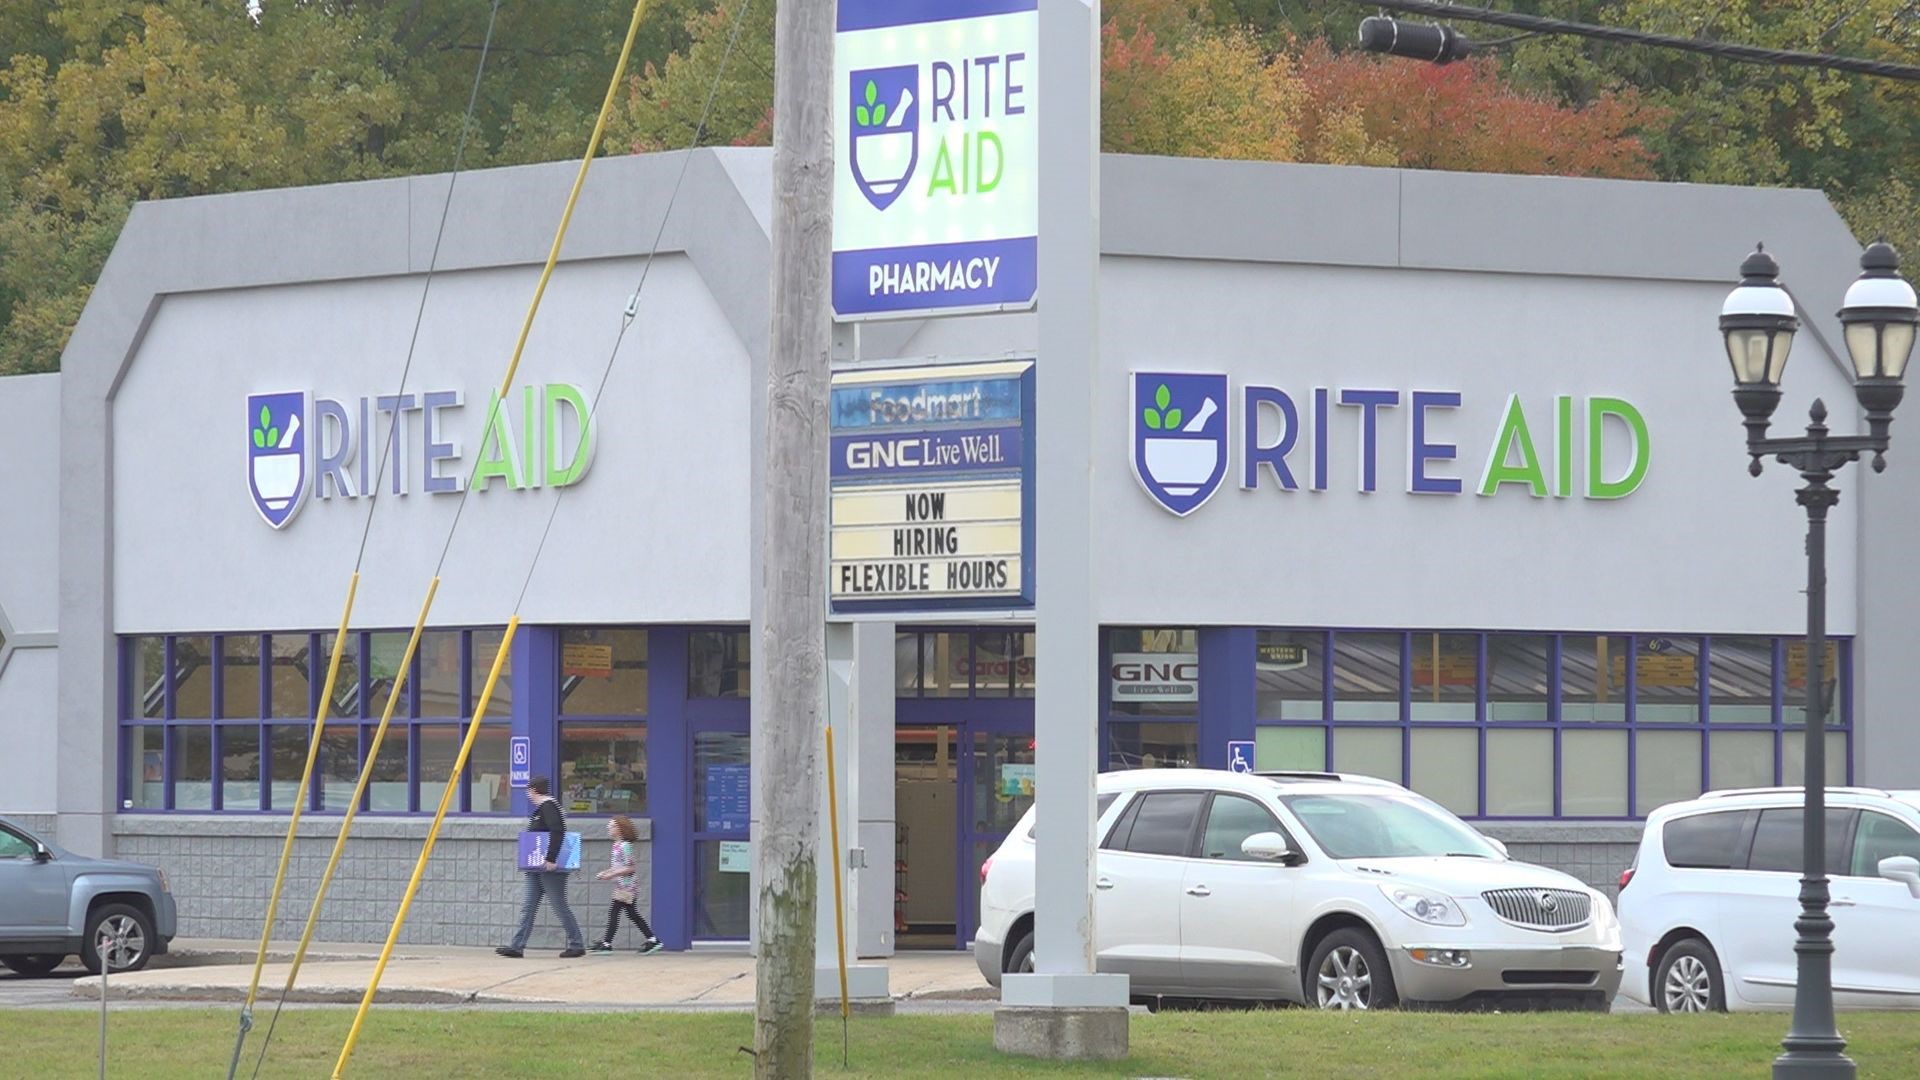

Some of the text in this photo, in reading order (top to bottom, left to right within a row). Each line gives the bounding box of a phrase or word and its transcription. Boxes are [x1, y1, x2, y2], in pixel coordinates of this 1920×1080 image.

[931, 52, 1026, 123] RITE
[926, 131, 1004, 198] AID
[869, 256, 1000, 296] PHARMACY
[869, 385, 982, 425] Foodmart
[314, 382, 597, 500] RITE AID
[846, 439, 919, 470] GNC
[922, 438, 961, 467] Live
[1239, 383, 1651, 500] RITE AID
[905, 492, 946, 522] NOW
[893, 526, 958, 557] HIRING
[841, 559, 1008, 593] FLEXIBLE HOURS
[1112, 663, 1199, 681] GNC
